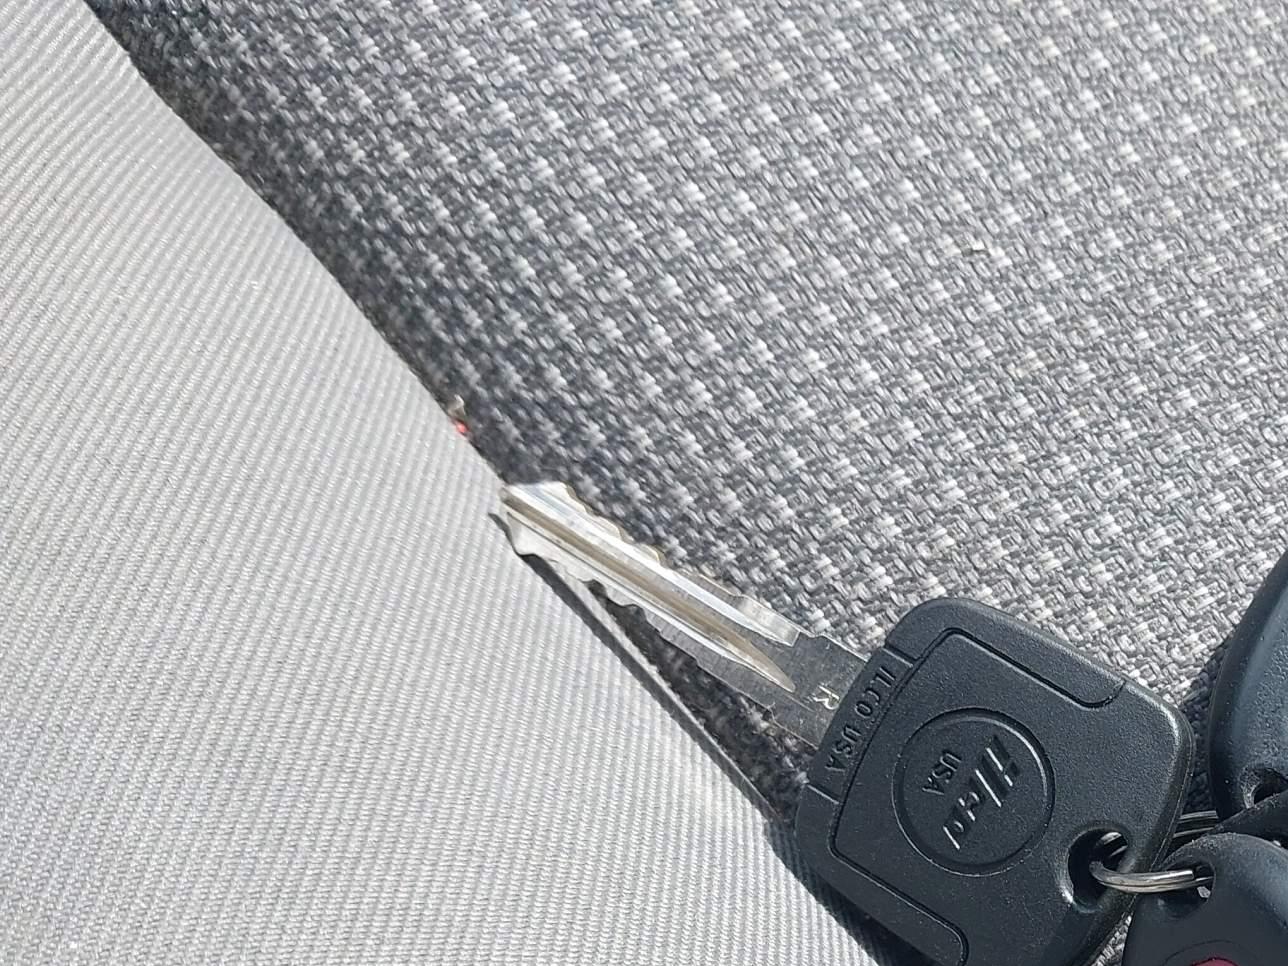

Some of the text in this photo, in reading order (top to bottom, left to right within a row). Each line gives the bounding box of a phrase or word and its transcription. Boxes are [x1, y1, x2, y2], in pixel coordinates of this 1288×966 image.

[825, 667, 896, 772] ILCO USA
[922, 749, 963, 797] USA
